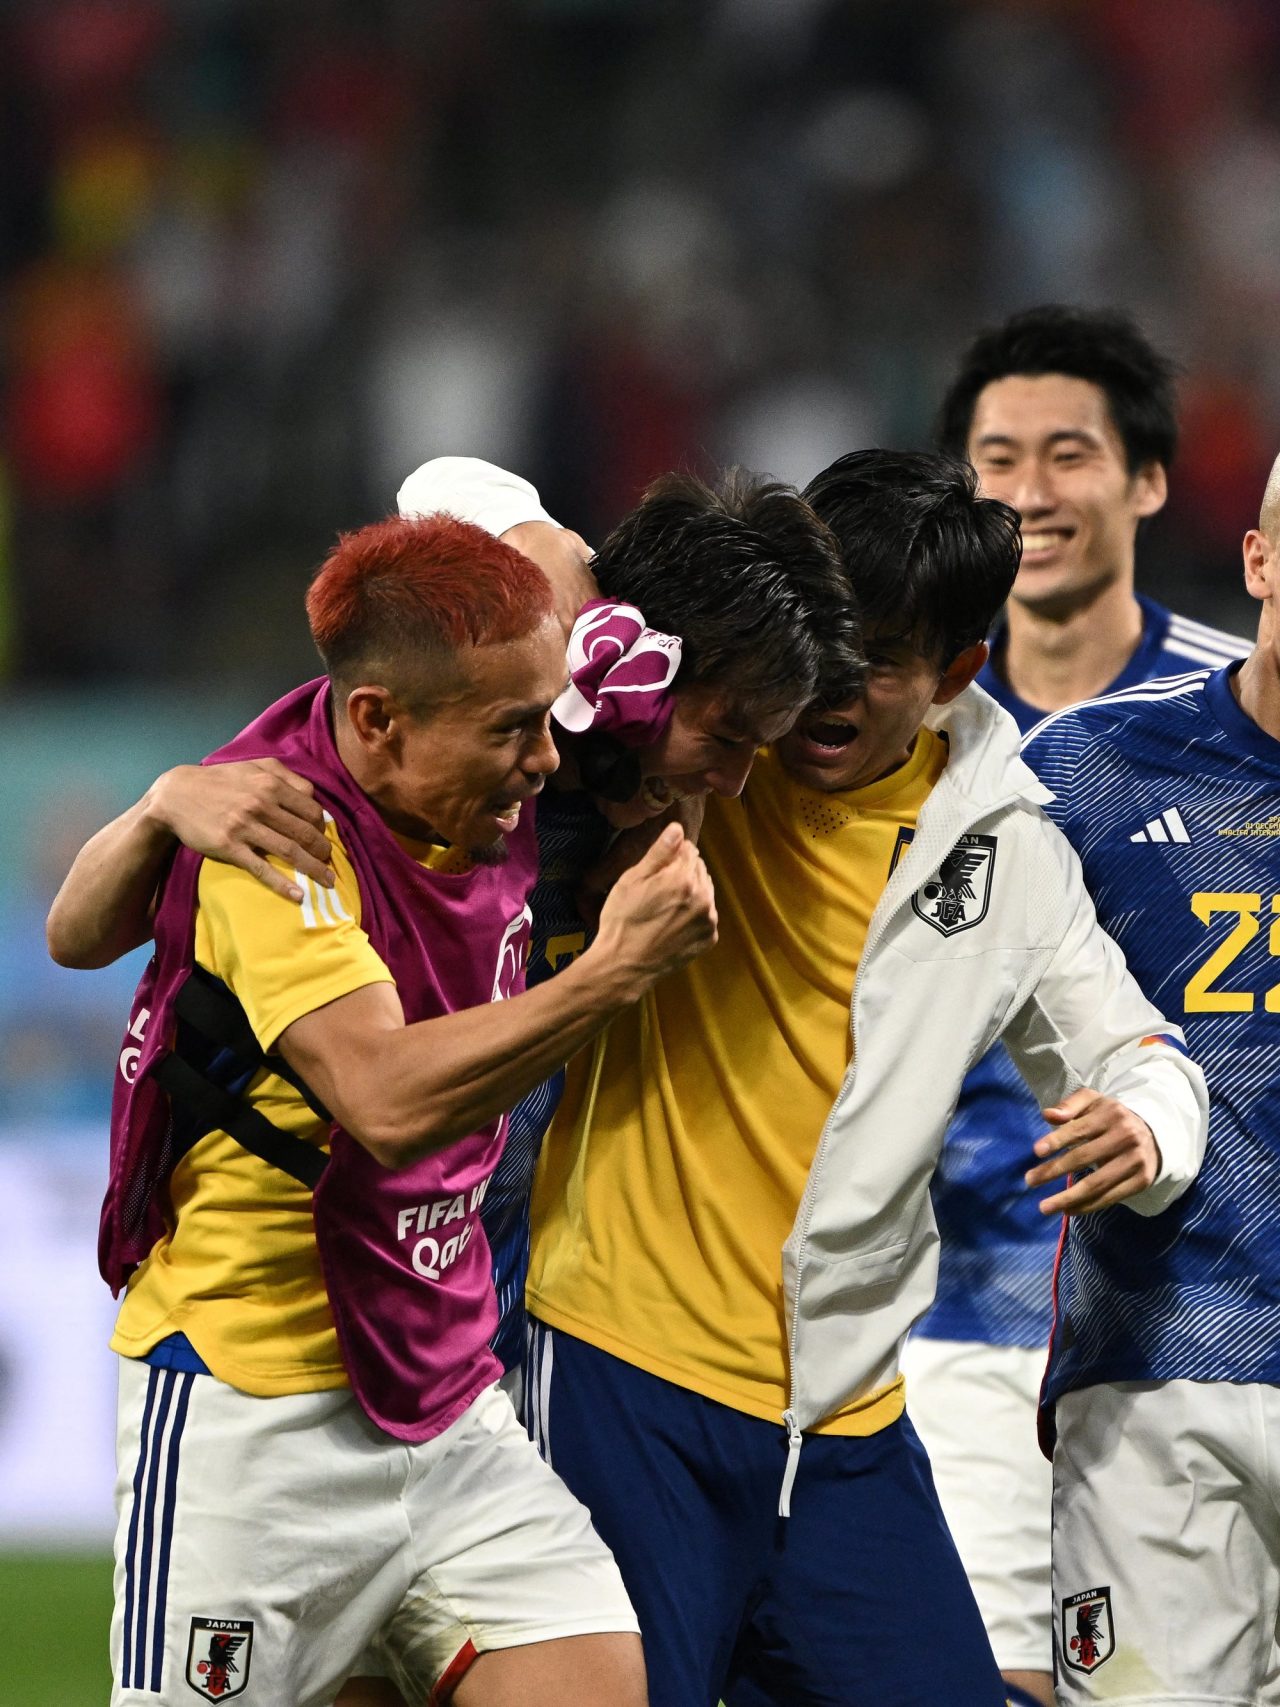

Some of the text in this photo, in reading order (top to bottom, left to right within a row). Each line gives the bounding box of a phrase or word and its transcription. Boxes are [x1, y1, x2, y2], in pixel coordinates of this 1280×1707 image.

[930, 900, 967, 921] JFA
[397, 1194, 466, 1241] FIFA
[412, 1221, 474, 1281] Qat
[1072, 1590, 1098, 1604] JAPAN
[205, 1619, 241, 1631] JAPAN
[201, 1675, 232, 1691] JFA
